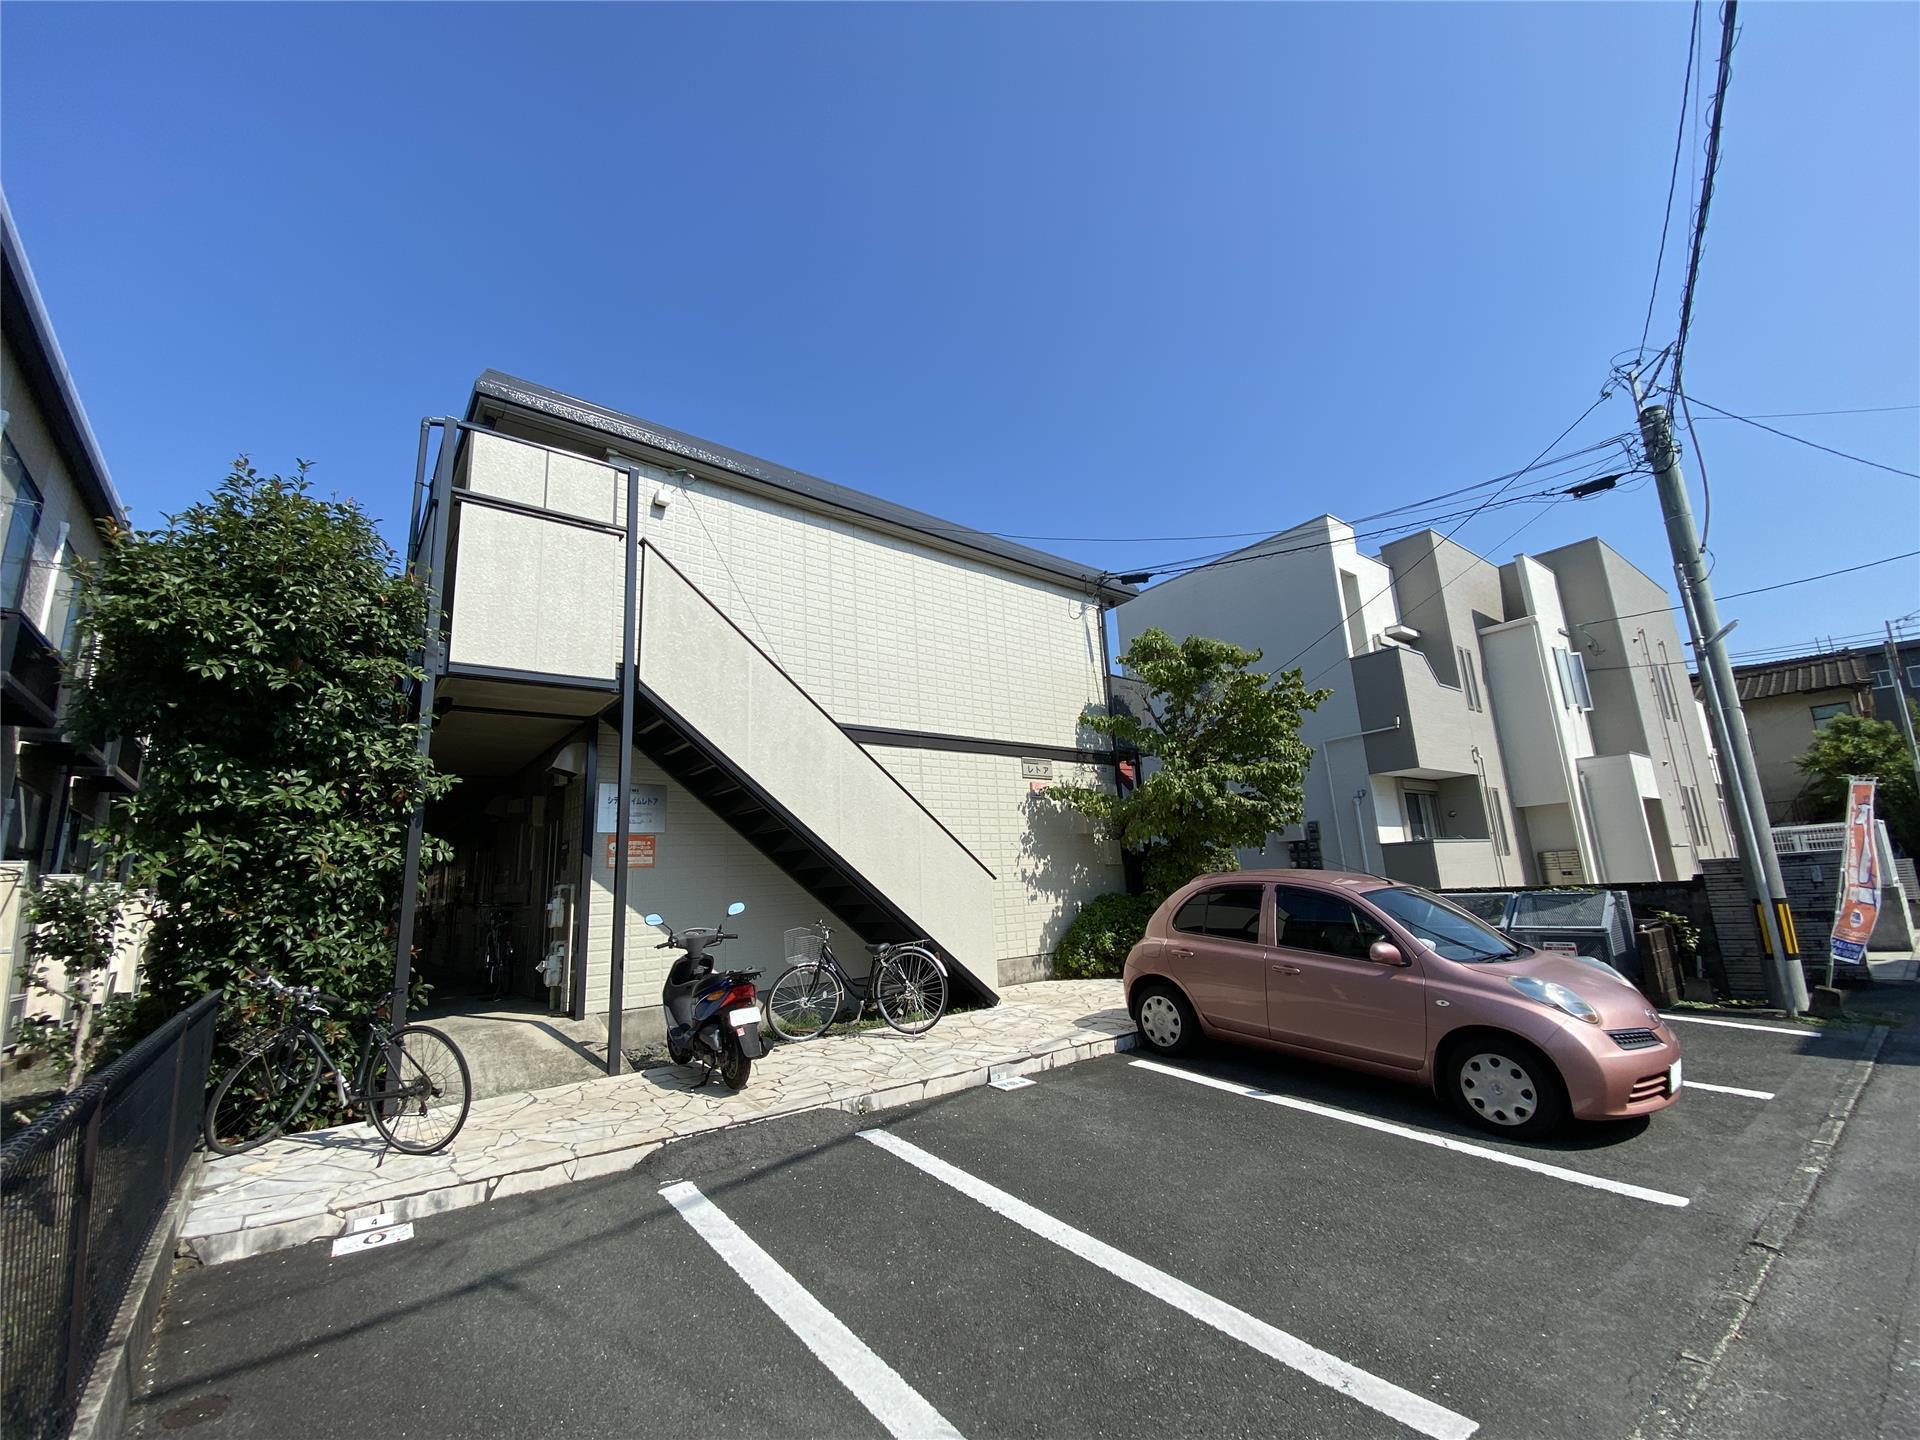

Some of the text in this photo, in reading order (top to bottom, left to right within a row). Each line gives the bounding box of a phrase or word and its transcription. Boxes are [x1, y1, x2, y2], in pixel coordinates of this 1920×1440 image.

[1027, 765, 1049, 774] レトア
[371, 1218, 378, 1226] 4
